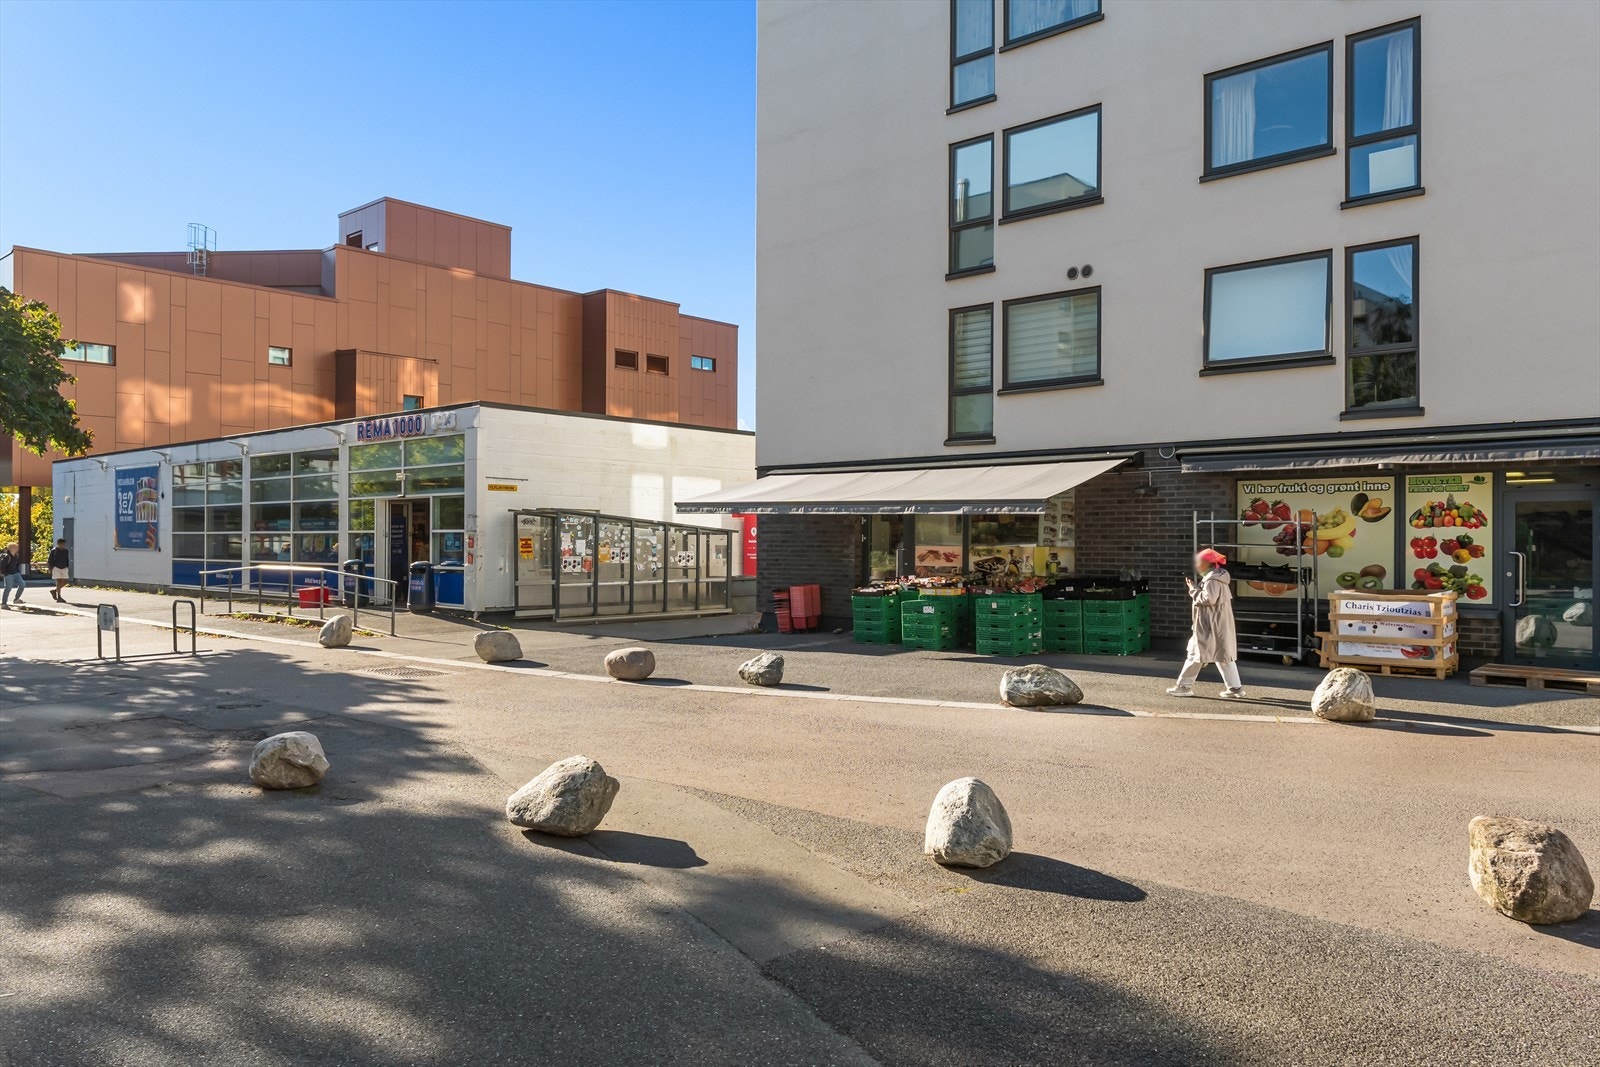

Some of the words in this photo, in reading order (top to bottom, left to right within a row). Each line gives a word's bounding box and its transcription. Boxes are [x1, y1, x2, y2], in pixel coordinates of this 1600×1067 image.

[357, 419, 391, 441] REMA
[393, 415, 423, 435] 1000
[1243, 484, 1256, 494] Vi
[1256, 484, 1277, 494] har
[1278, 482, 1307, 493] frukt
[1309, 484, 1325, 494] og
[1327, 481, 1360, 494] grønt
[1363, 481, 1390, 492] inne
[1345, 601, 1374, 611] Charis
